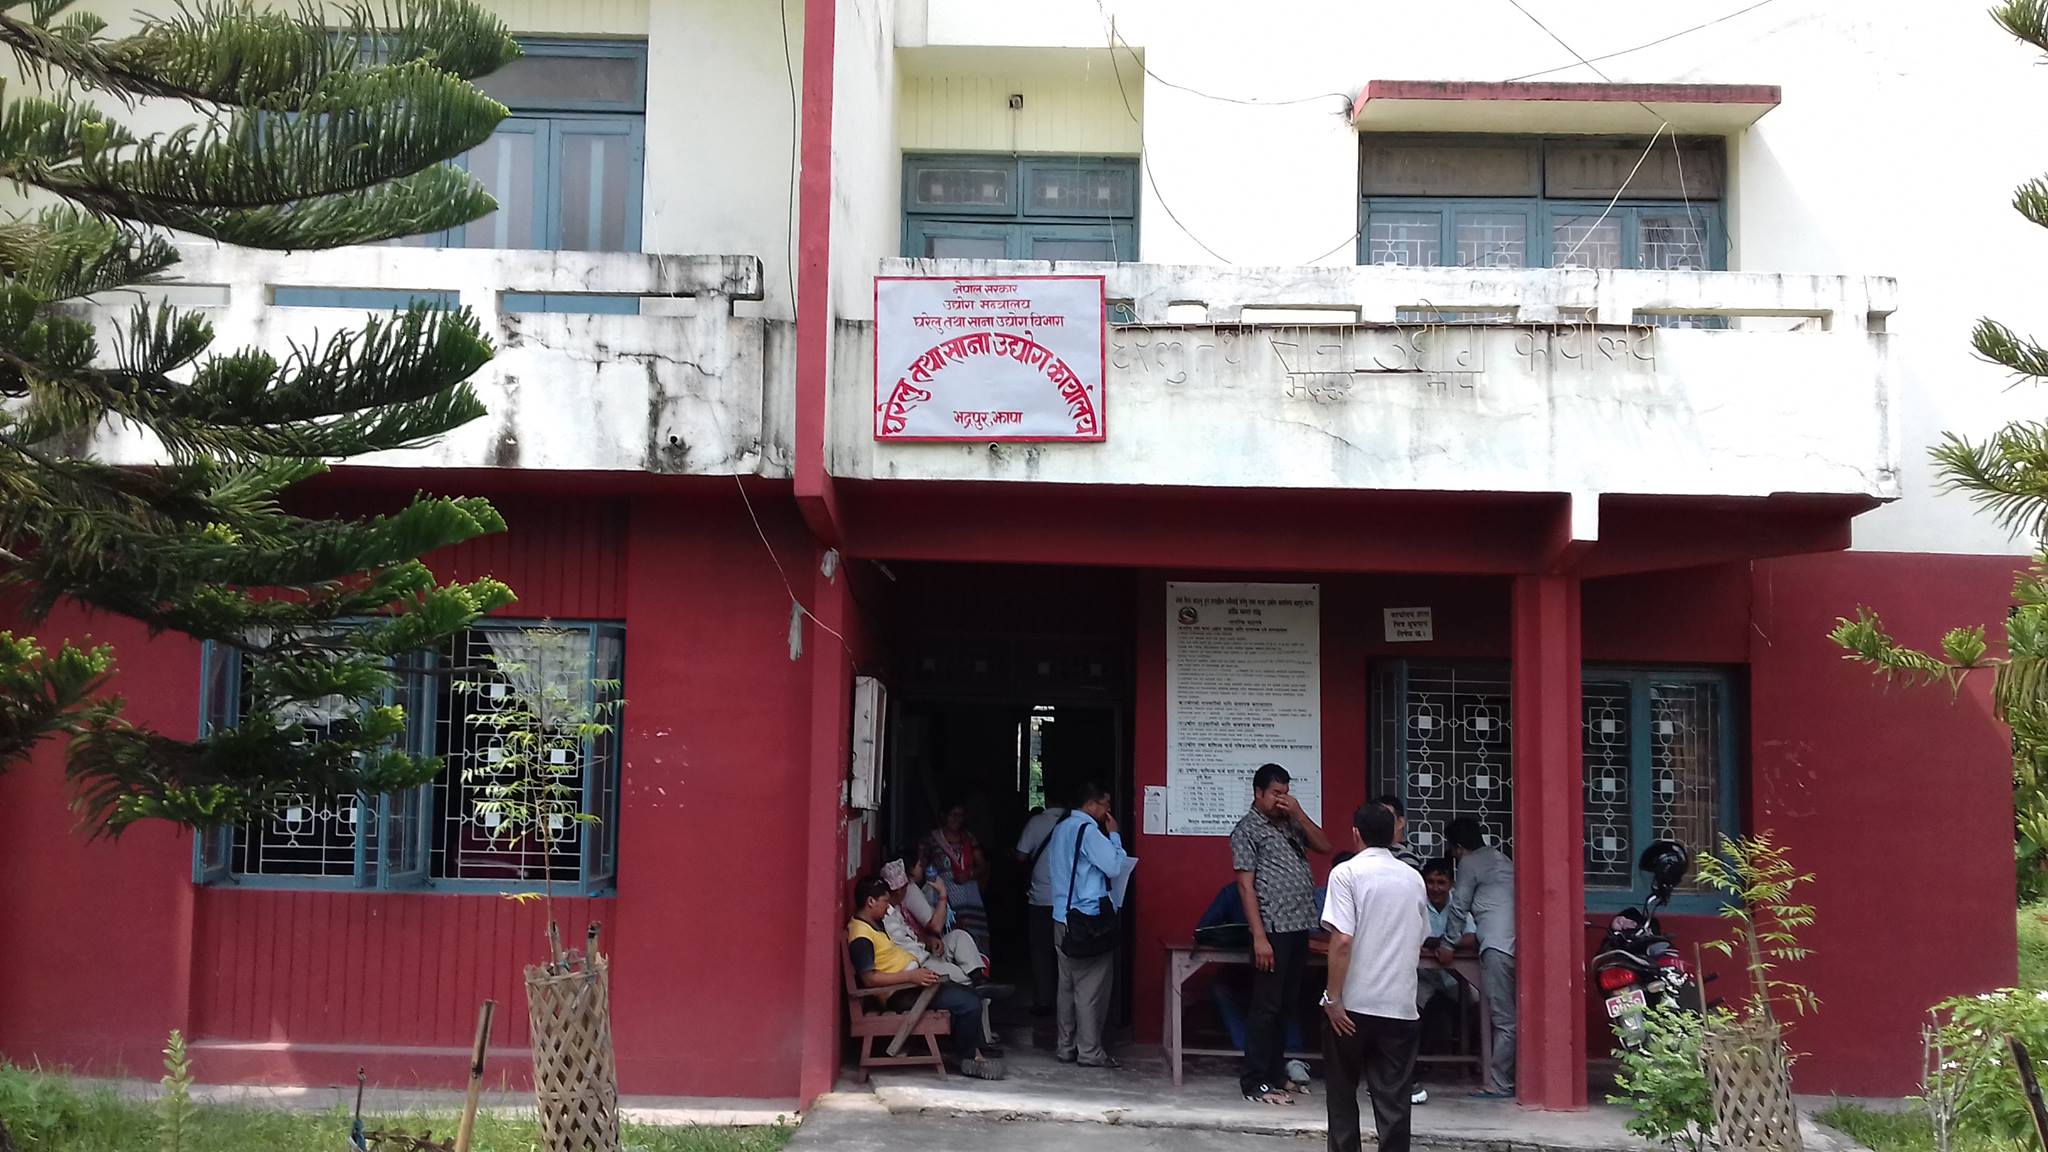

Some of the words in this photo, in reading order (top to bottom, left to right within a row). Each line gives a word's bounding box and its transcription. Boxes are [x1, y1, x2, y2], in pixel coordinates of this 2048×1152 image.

[953, 281, 982, 294] नेपाल
[984, 284, 1019, 294] सरकार
[943, 296, 975, 311] उद्योग
[913, 312, 944, 334] घरेलु
[944, 316, 967, 328] तथा
[967, 316, 994, 328] साना
[996, 312, 1028, 328] उद्योग
[1030, 312, 1065, 328] विभाग
[877, 377, 932, 436] घरेलु
[907, 350, 948, 384] तथा
[941, 332, 992, 364] साना
[991, 330, 1054, 373] उद्योग
